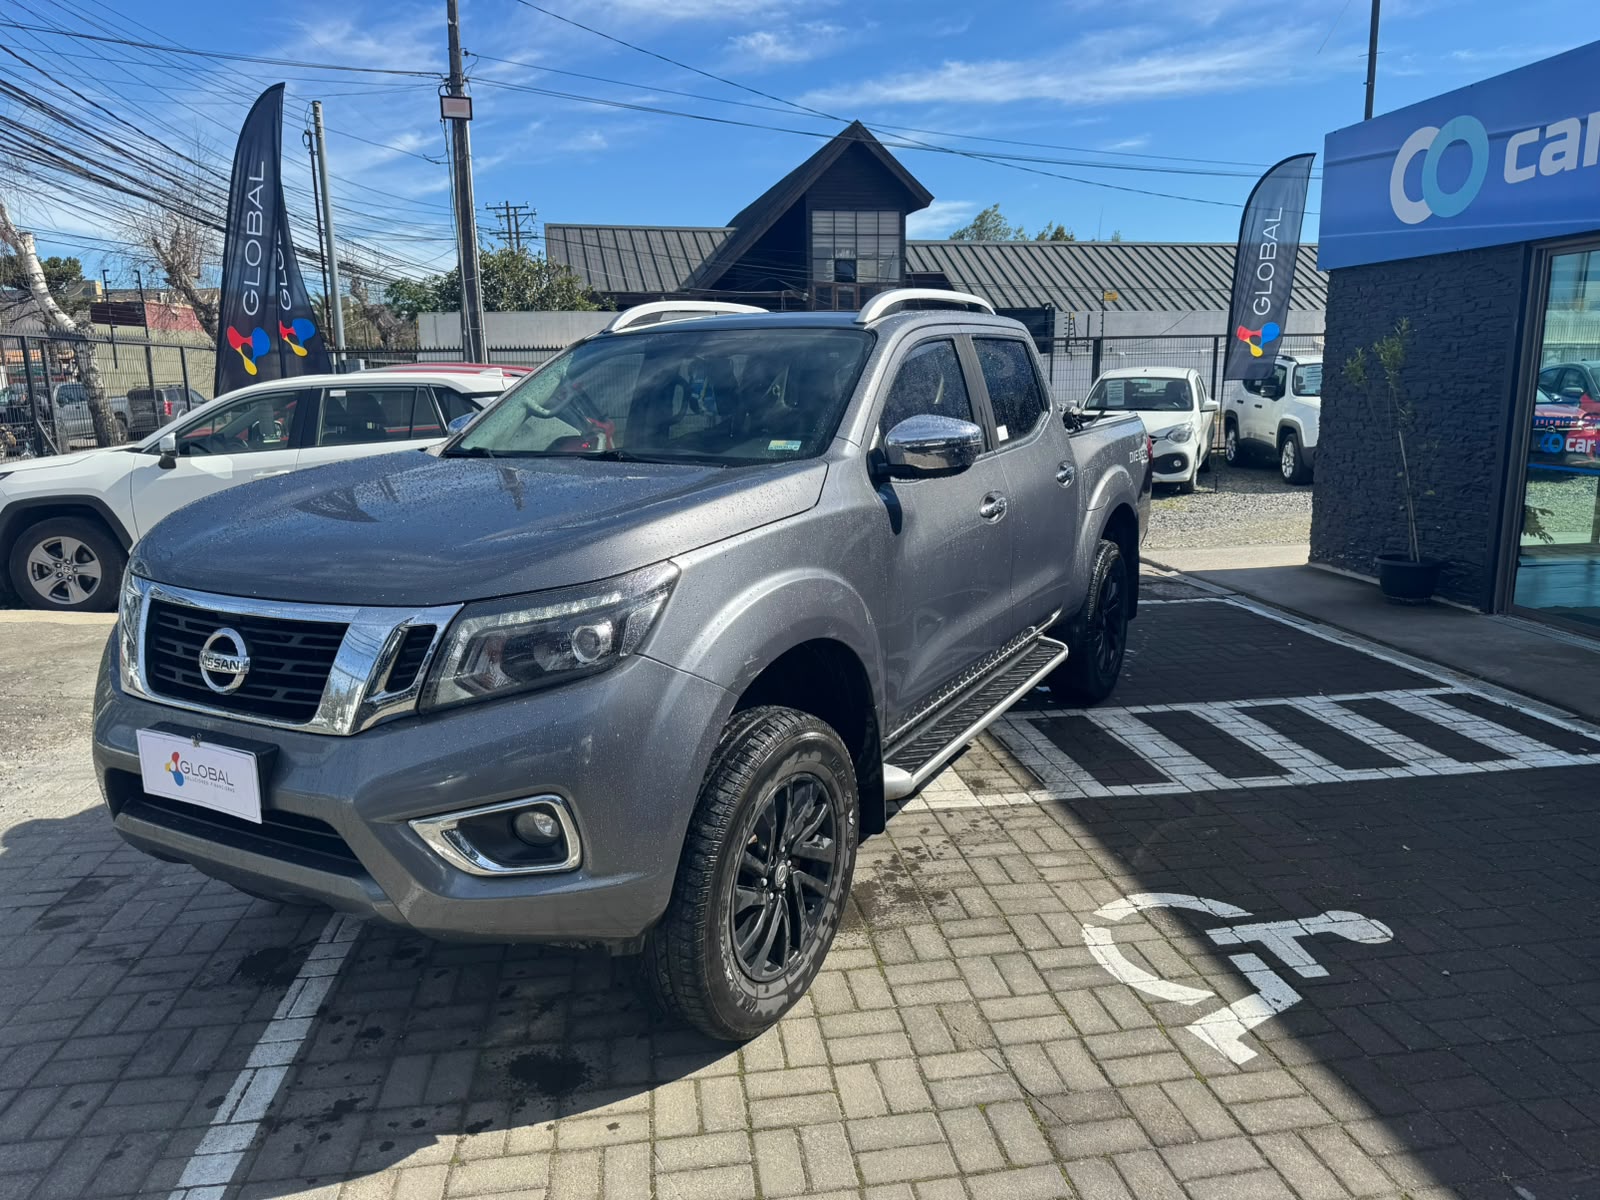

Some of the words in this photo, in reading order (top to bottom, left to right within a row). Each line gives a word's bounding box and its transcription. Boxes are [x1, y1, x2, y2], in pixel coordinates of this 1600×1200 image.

[242, 161, 265, 316] GLOBAL
[1252, 207, 1283, 316] GLOBAL
[200, 653, 241, 671] NISSAN
[180, 760, 234, 787] GLOBAL
